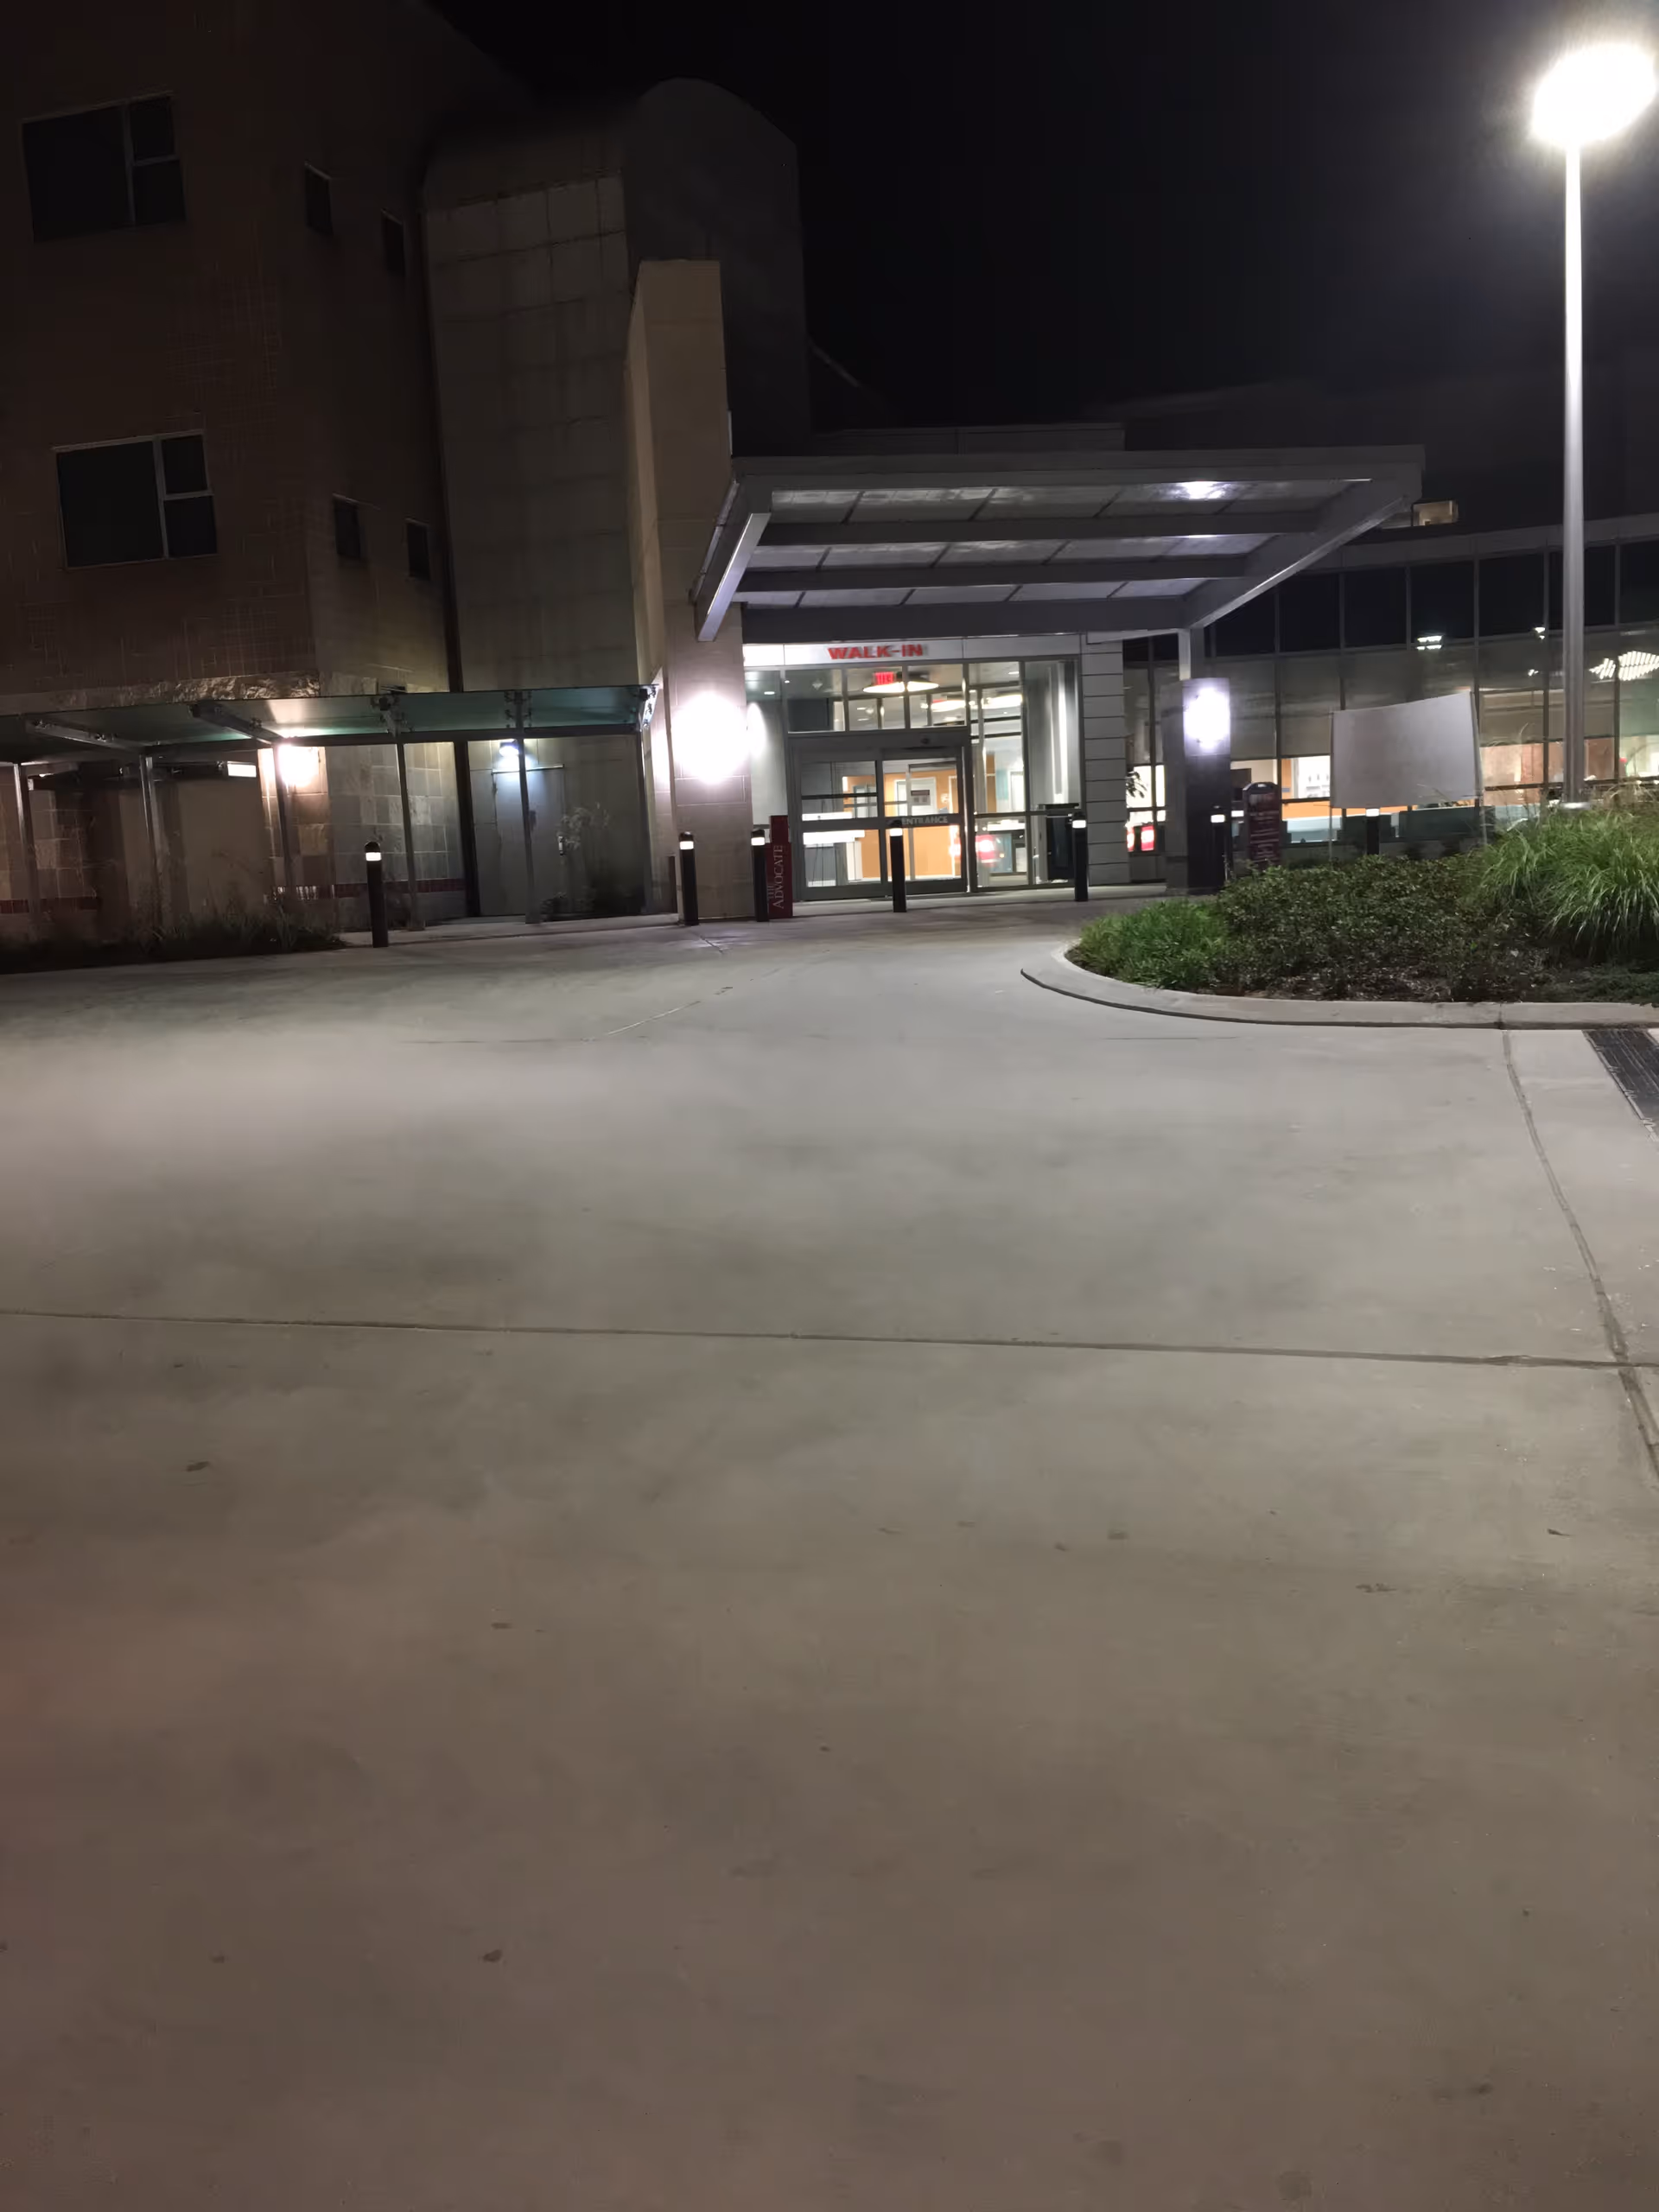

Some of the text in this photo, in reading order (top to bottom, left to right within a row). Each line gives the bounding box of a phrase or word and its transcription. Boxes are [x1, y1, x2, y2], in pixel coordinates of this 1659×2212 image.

[828, 644, 923, 659] WALK-IN
[901, 816, 948, 825] ENTRANCE
[772, 845, 785, 909] ADVOCATE
